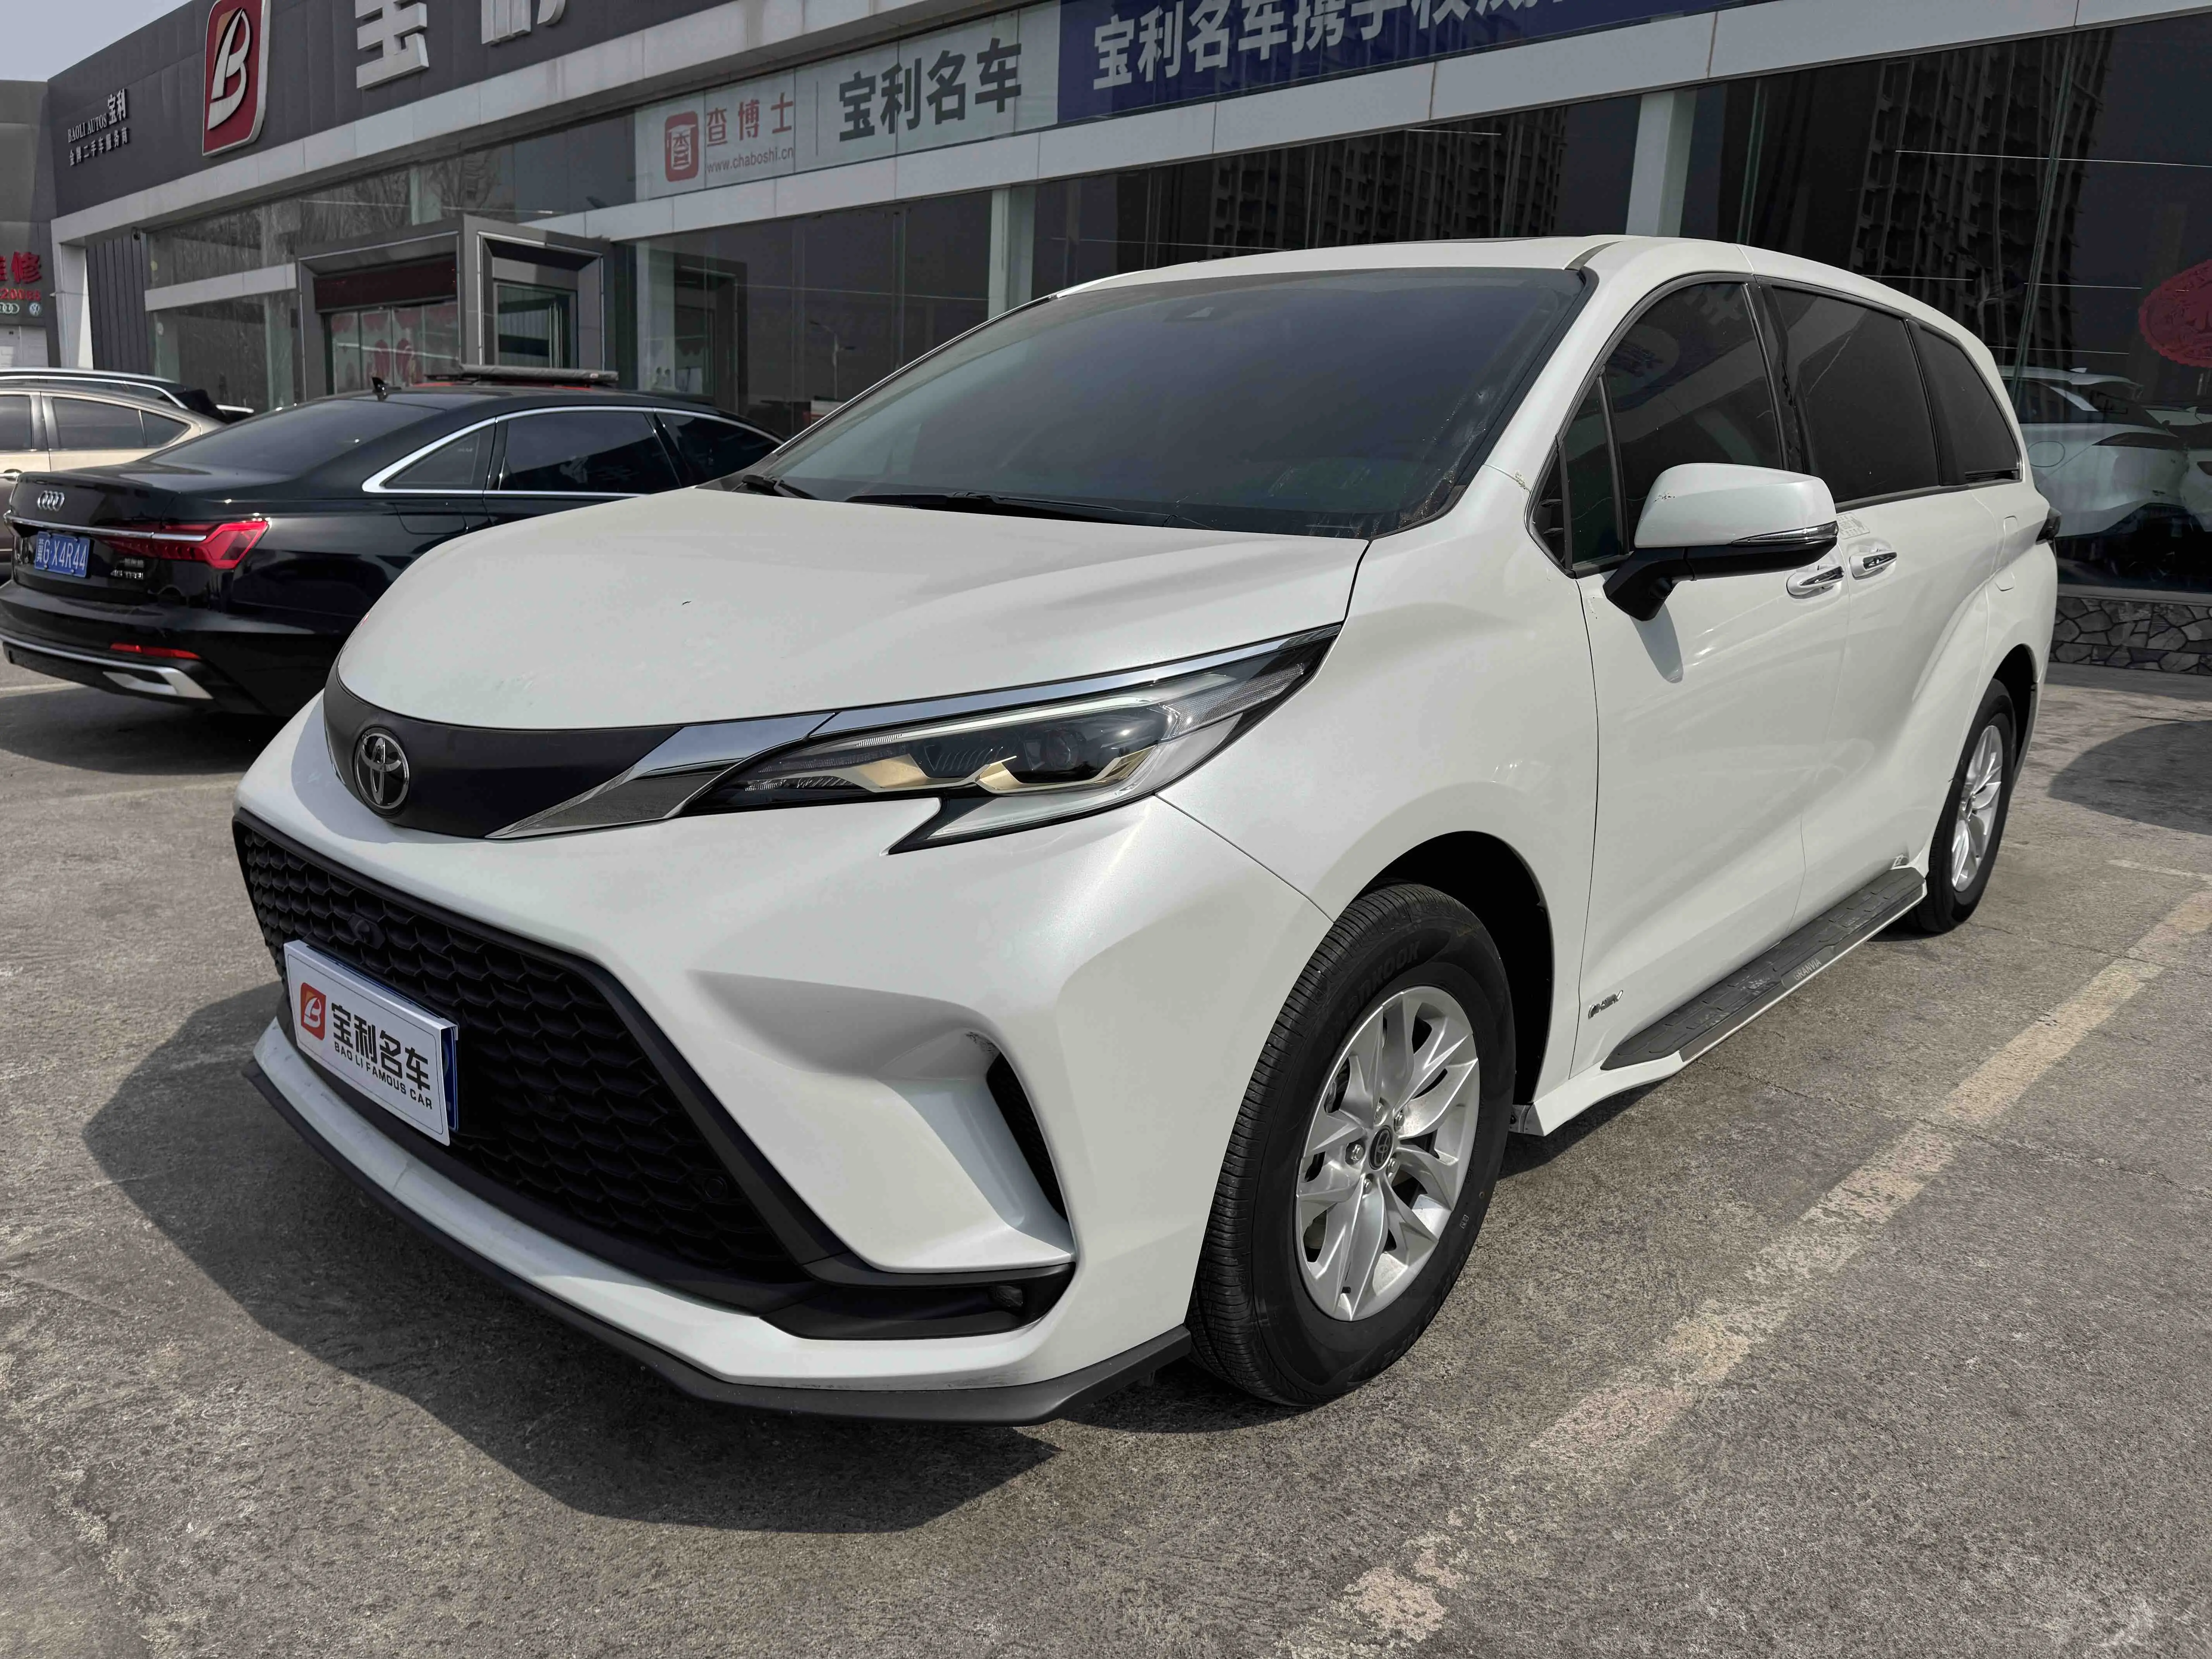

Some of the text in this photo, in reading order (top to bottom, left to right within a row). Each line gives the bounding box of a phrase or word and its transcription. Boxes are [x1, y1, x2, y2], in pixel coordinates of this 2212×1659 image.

[68, 88, 126, 143] BAOLI AUTOS 宝利
[839, 38, 1022, 142] 宝利名车
[707, 93, 793, 147] 查博士
[707, 146, 794, 173] www.chaboshi.cn
[1793, 958, 1822, 980] GRANVIA
[331, 1003, 430, 1091] 宝利名车
[335, 1041, 432, 1109] BAO LI FAMOUS CAR
